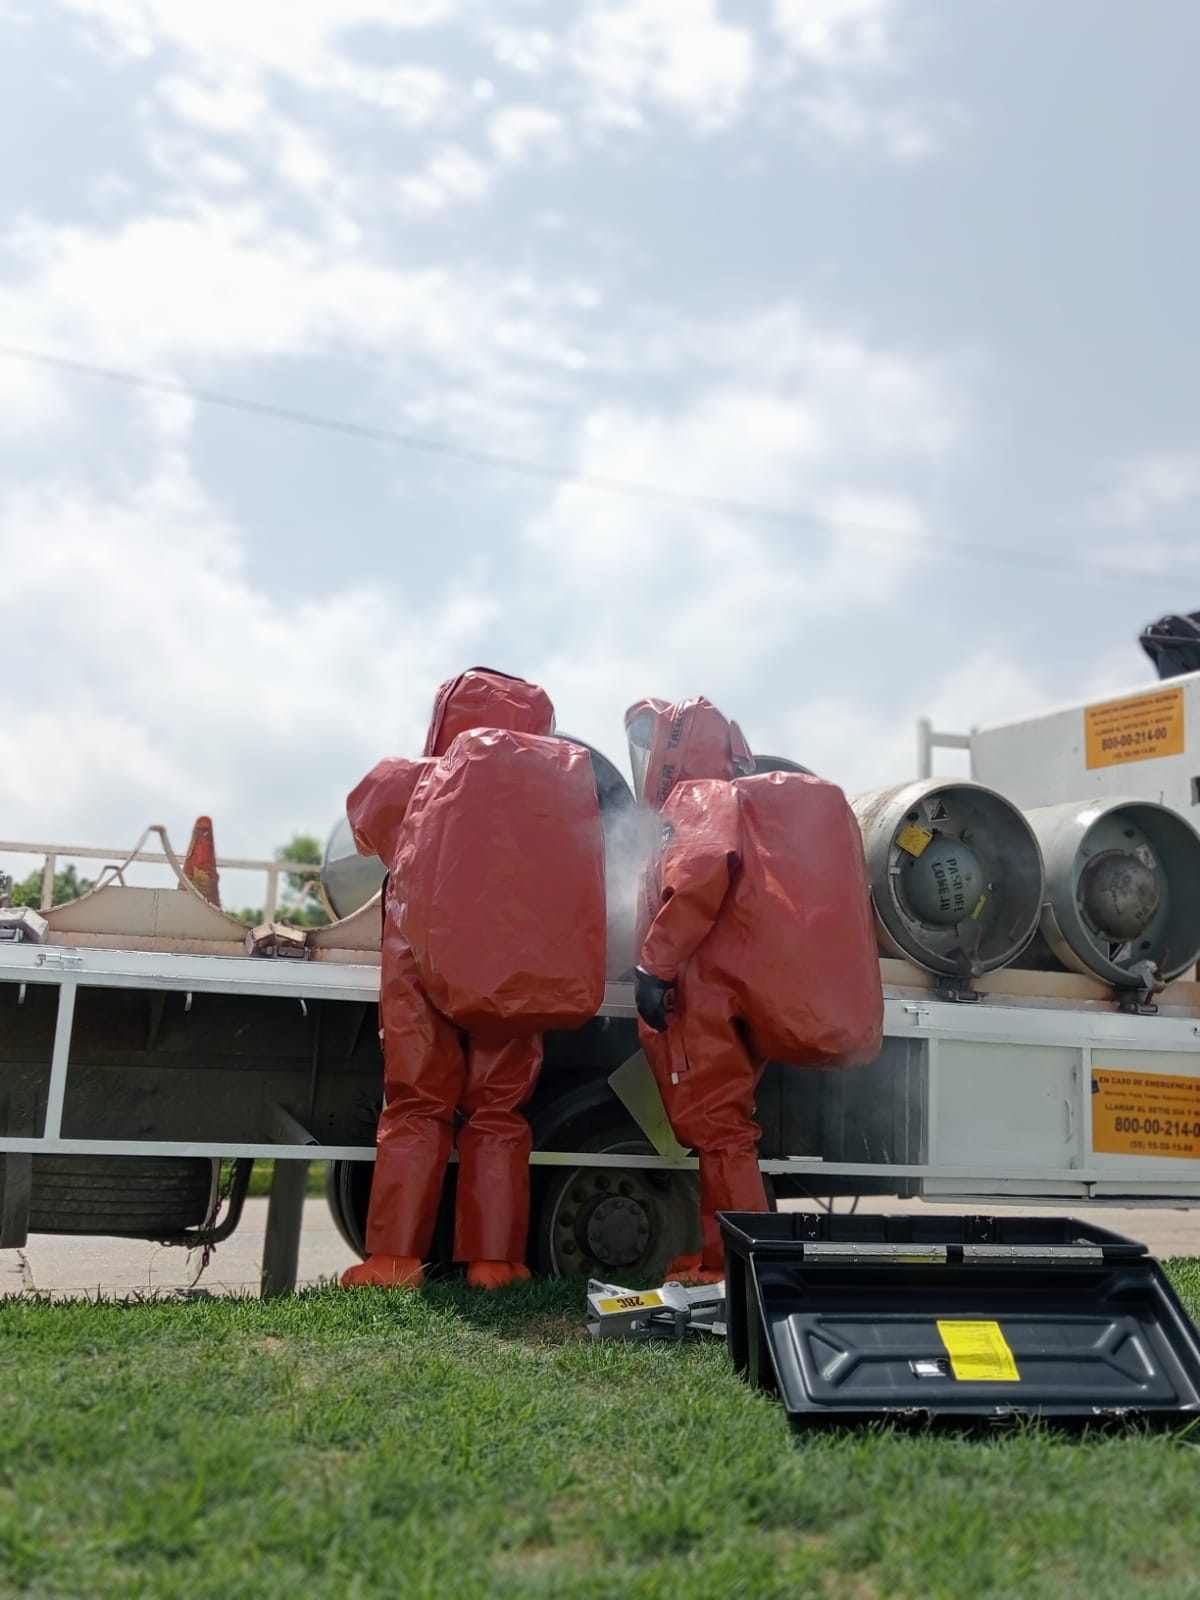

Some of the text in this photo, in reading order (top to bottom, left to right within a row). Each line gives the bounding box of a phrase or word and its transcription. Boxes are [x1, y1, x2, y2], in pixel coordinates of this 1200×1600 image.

[1101, 726, 1167, 752] 800-00-214-00
[953, 893, 964, 912] DEL
[1099, 1076, 1109, 1084] EN
[1112, 1077, 1131, 1085] CASO
[1133, 1078, 1143, 1086] DE
[1145, 1079, 1193, 1090] EMERGENCIA
[1104, 1103, 1135, 1112] LLAMAR
[615, 1295, 645, 1309] 28C
